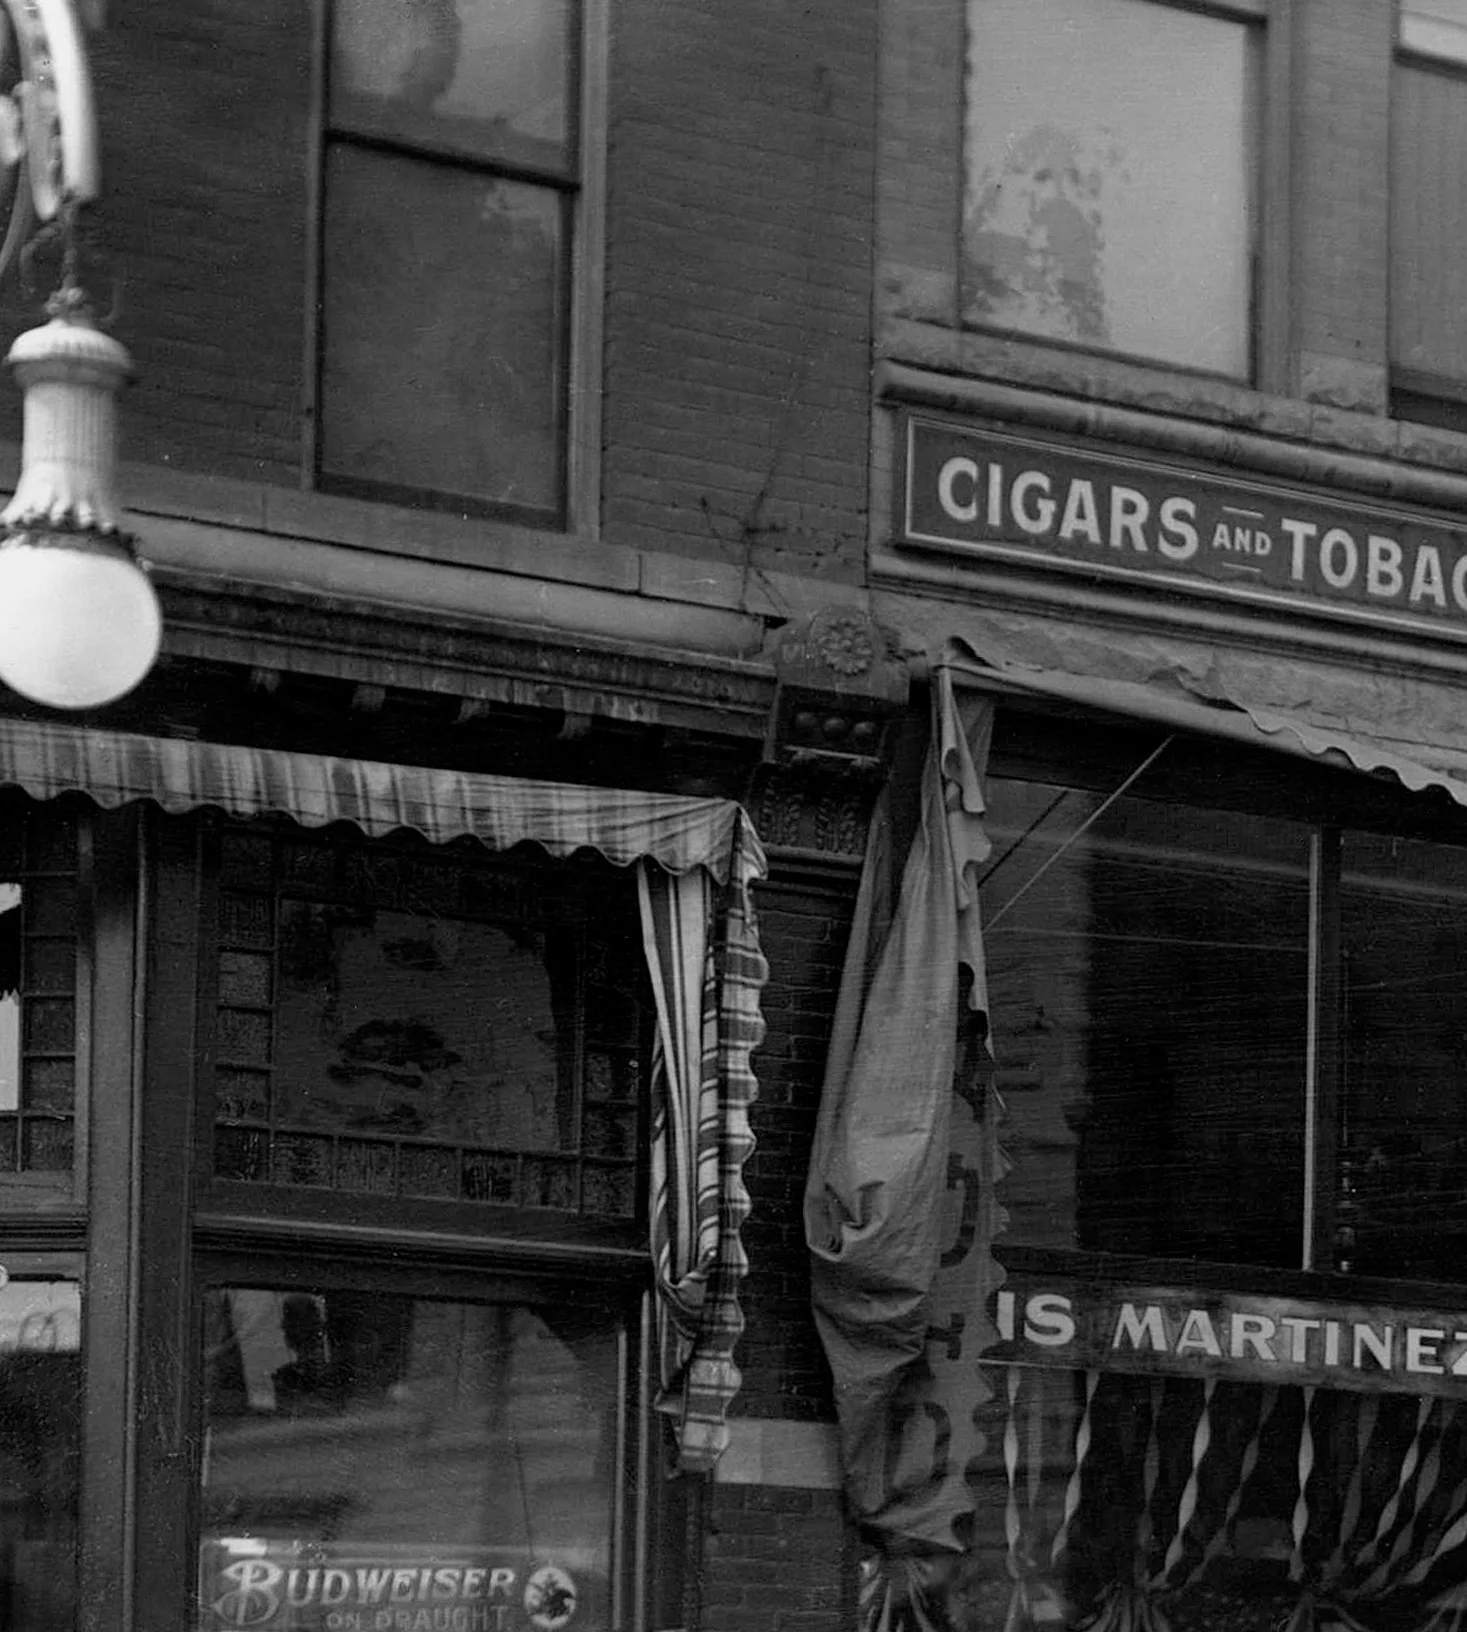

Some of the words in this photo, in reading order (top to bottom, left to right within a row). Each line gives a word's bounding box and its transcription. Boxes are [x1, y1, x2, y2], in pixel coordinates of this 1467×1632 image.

[937, 456, 1198, 561] CIGARS
[1213, 522, 1273, 557] AND
[212, 1558, 517, 1627] BUDWEISER
[326, 1609, 362, 1631] ON
